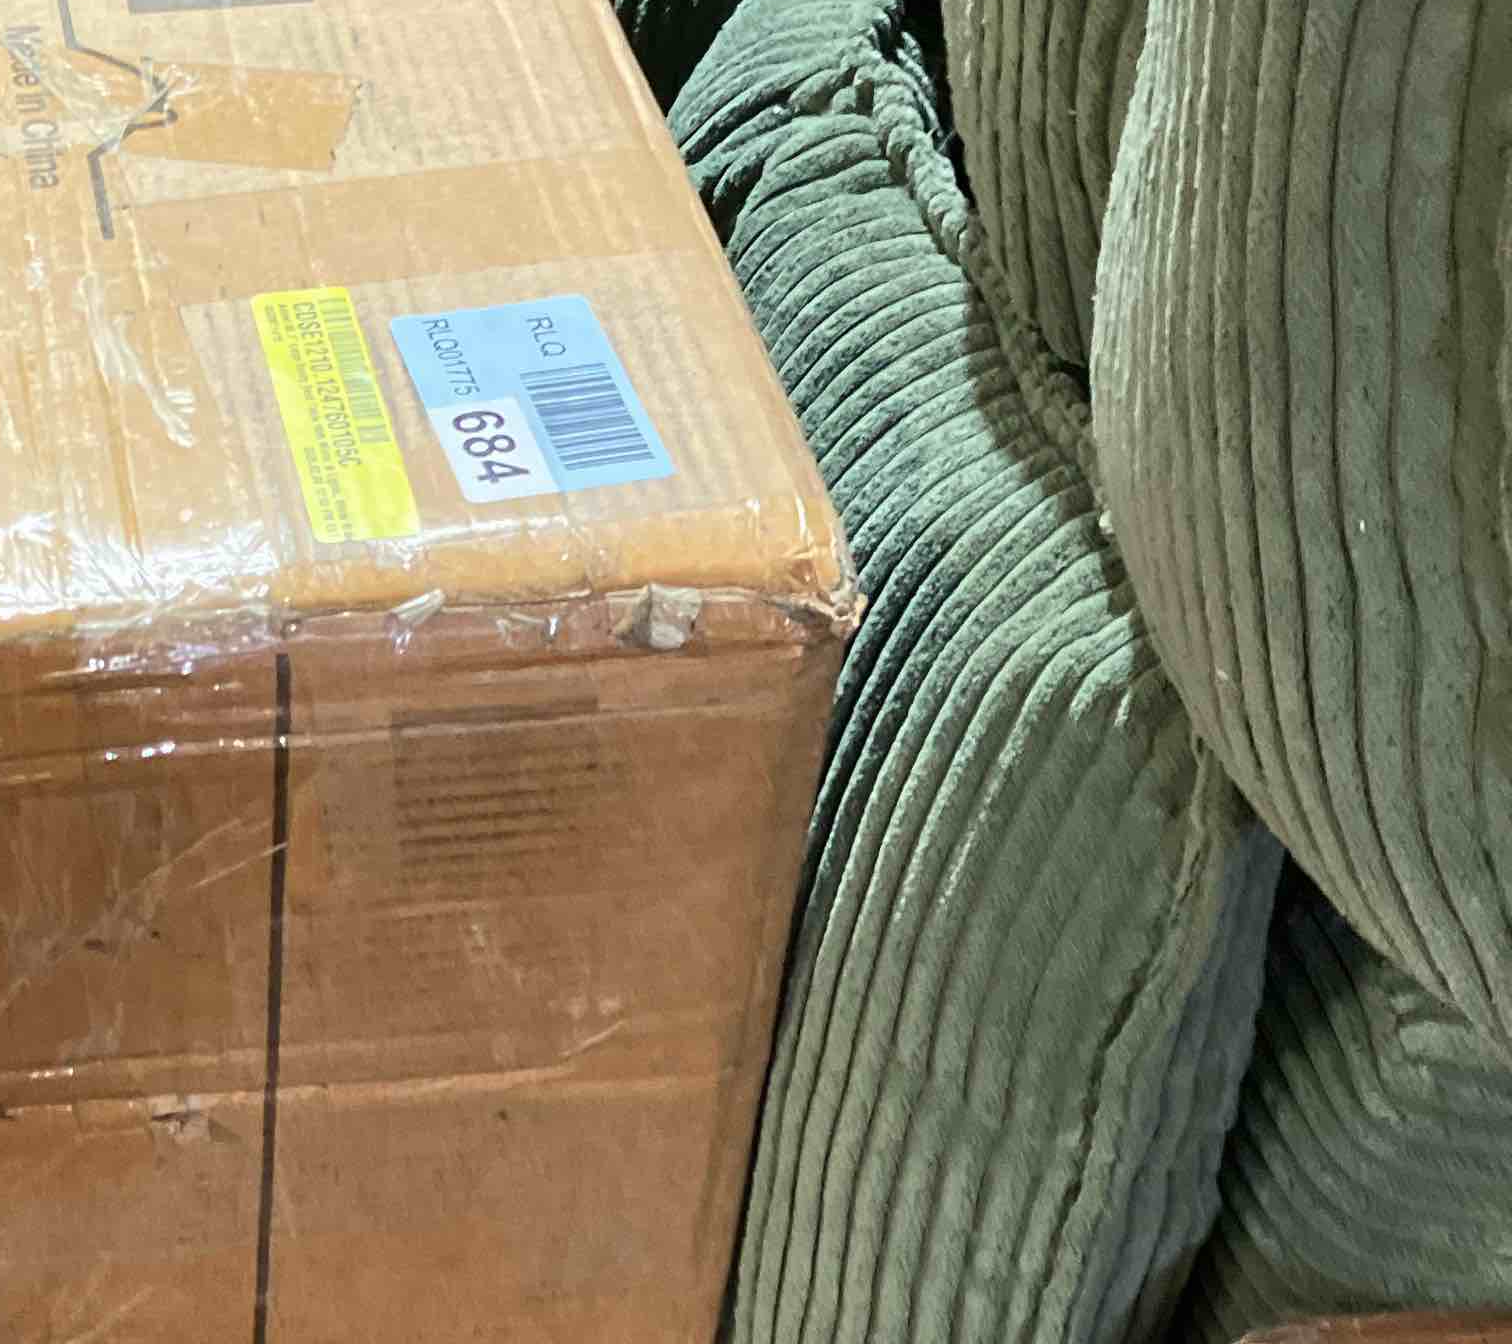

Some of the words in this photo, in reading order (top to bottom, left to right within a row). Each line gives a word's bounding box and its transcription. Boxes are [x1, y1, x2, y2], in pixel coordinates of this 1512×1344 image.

[22, 118, 59, 191] China
[422, 317, 480, 397] RLQ01775
[525, 312, 567, 358] RLQ
[452, 410, 531, 484] 684
